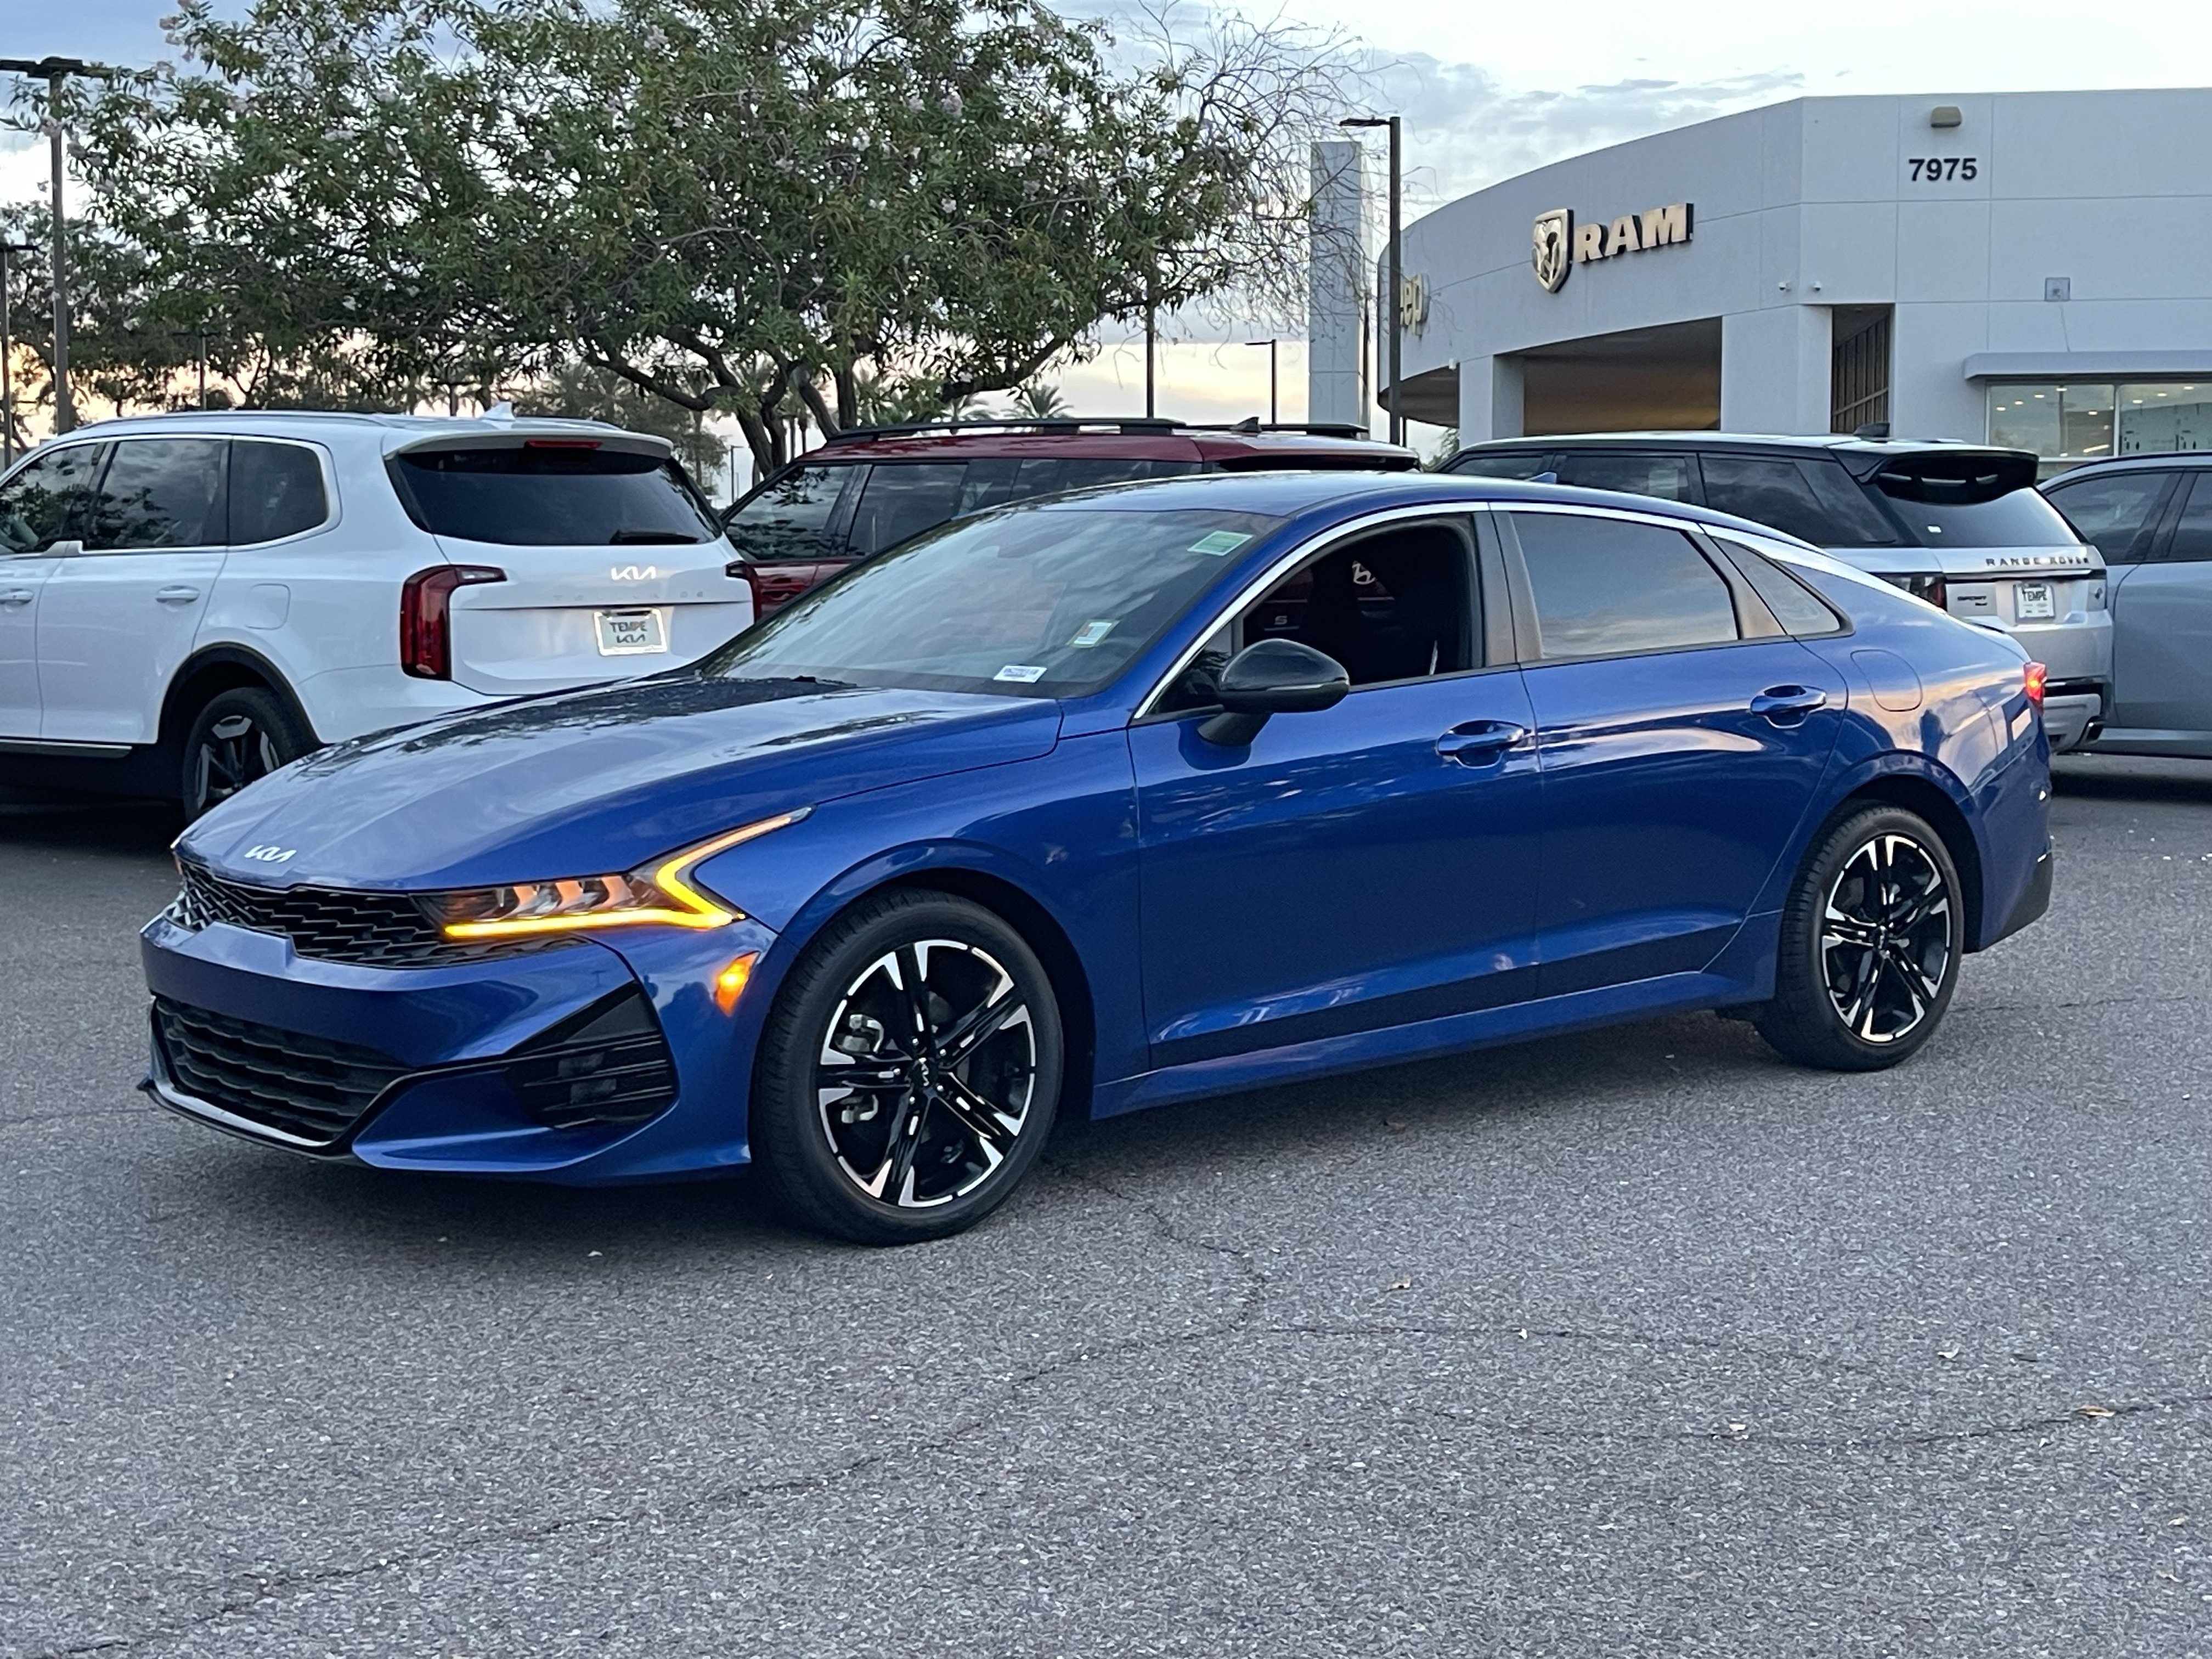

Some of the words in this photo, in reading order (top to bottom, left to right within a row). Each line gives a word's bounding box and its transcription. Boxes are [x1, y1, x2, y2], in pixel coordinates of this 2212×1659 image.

[1908, 157, 1978, 182] 7975
[1573, 203, 1694, 264] RAM
[1985, 557, 2041, 566] RANGE
[610, 566, 657, 580] KIA
[244, 844, 297, 864] KIA
